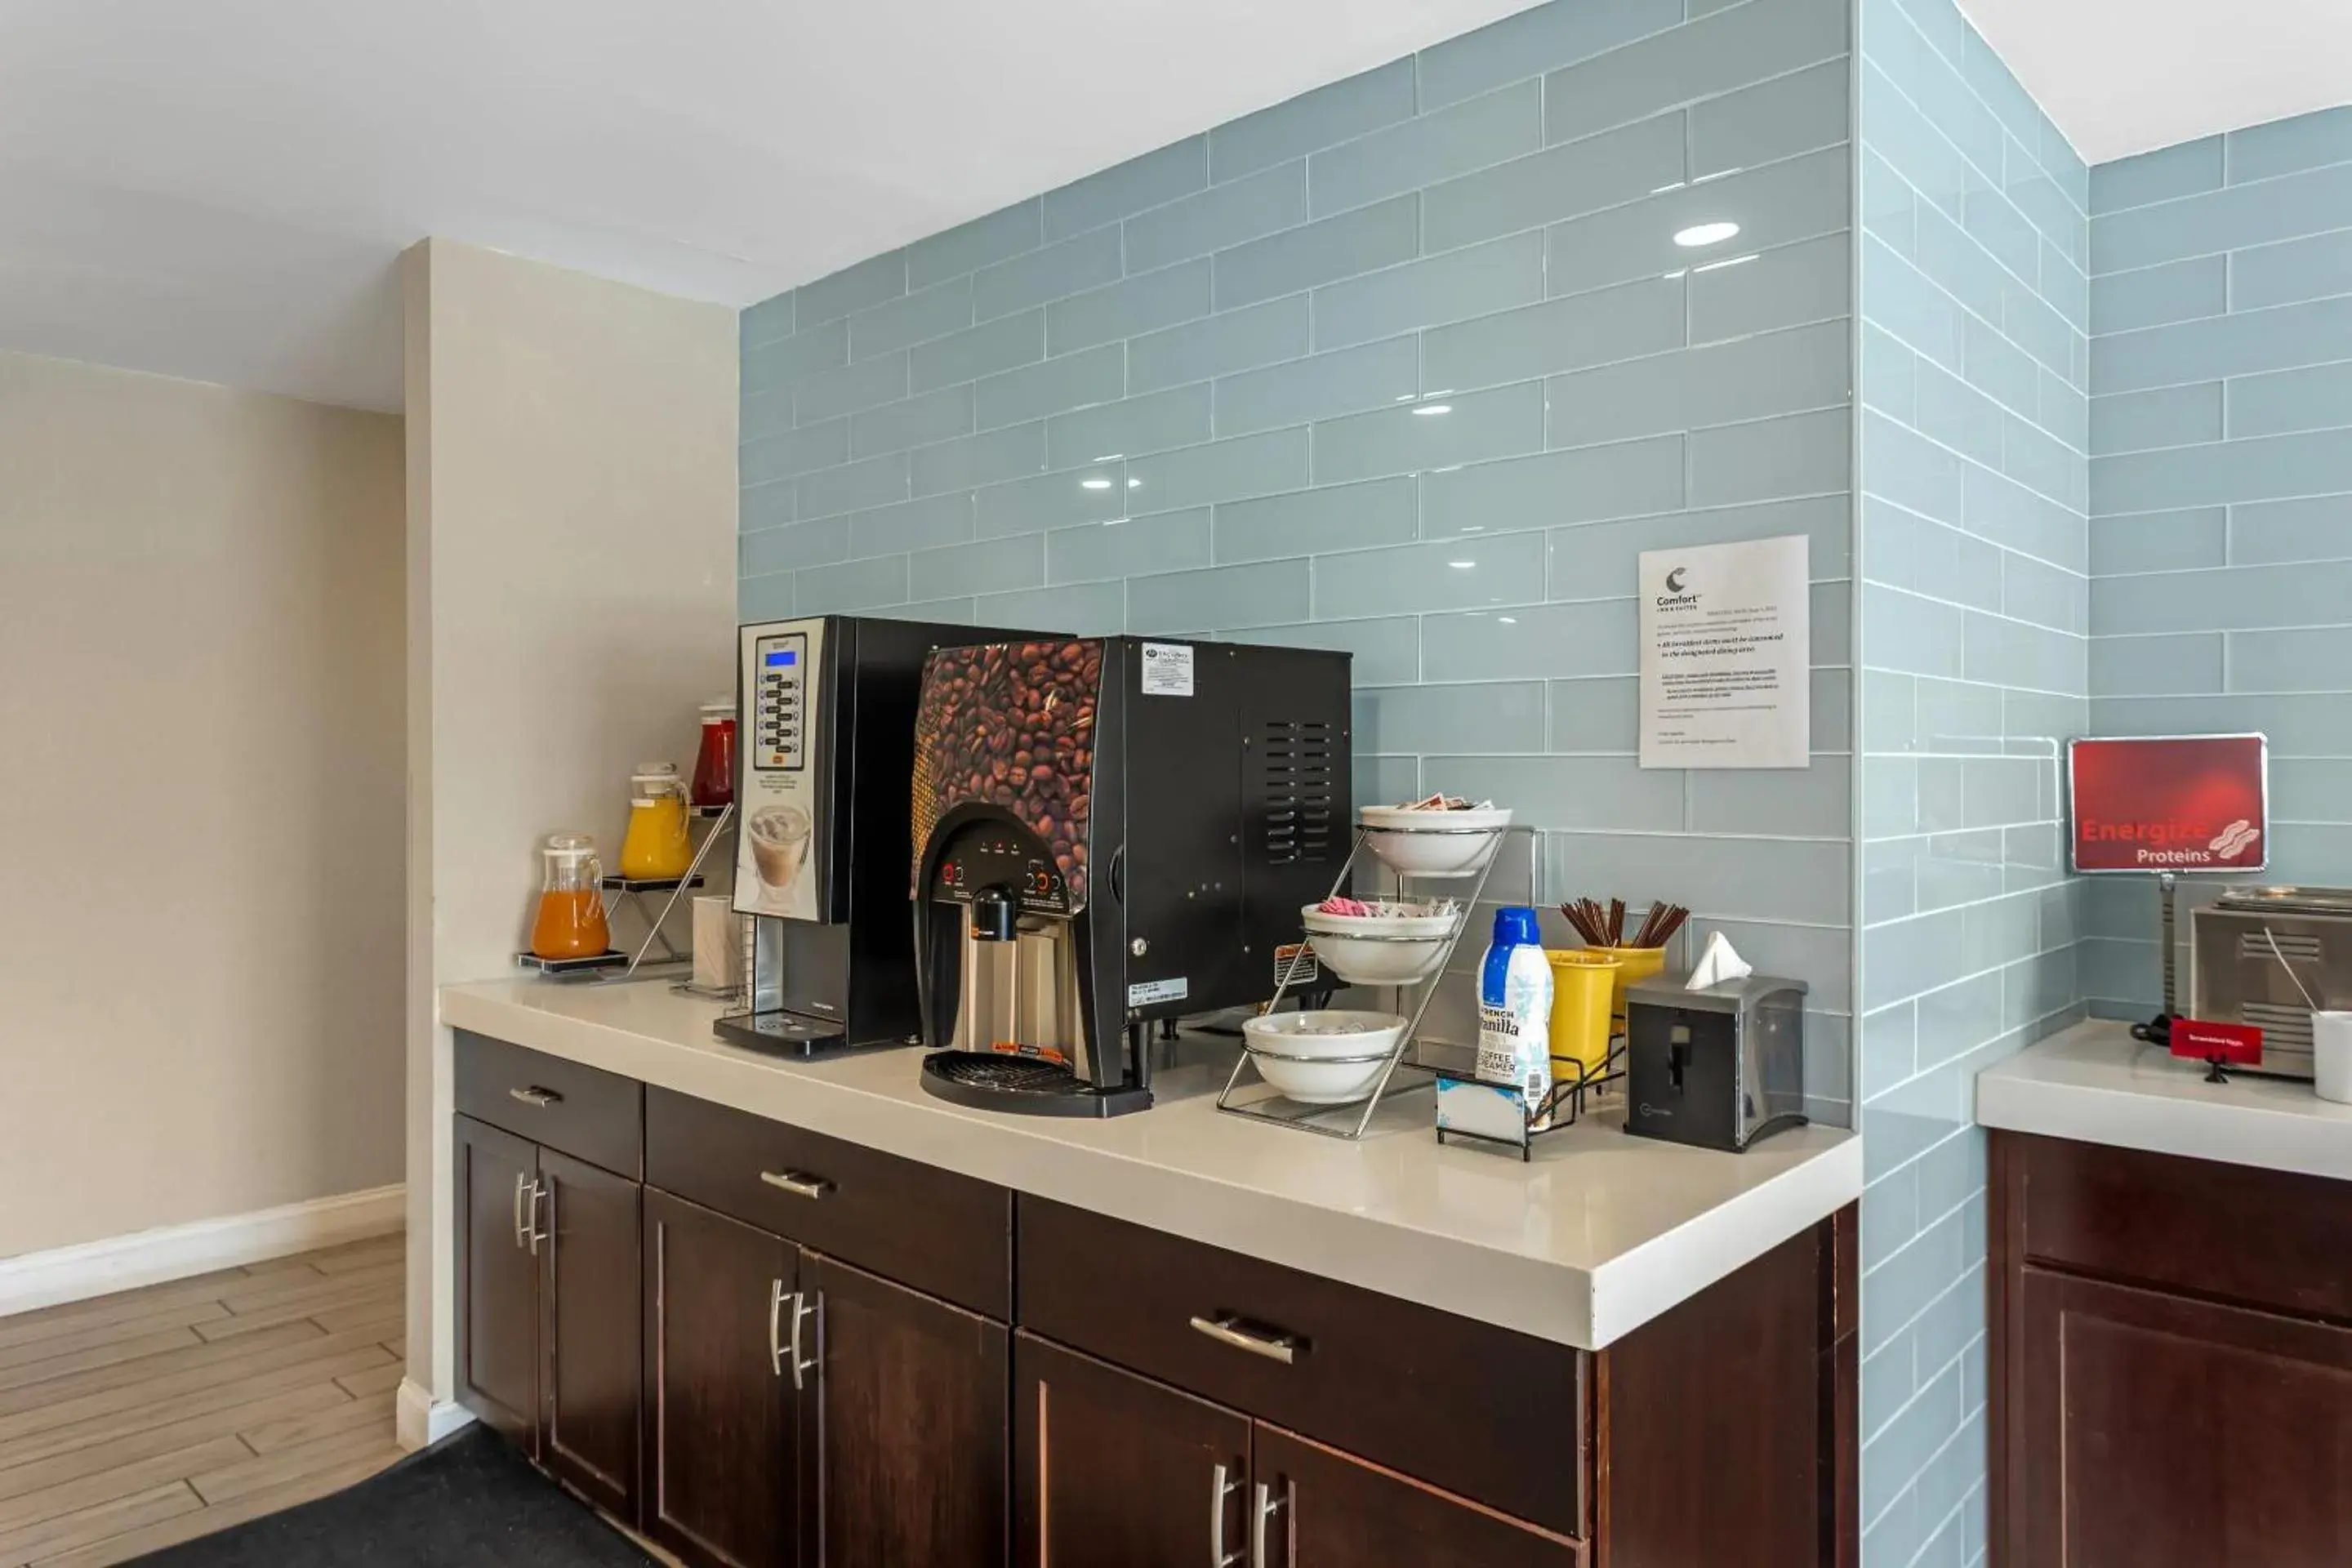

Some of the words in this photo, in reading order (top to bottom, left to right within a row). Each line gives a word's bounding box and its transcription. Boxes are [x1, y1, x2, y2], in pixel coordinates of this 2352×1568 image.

[1657, 595, 1697, 606] Comfort
[2082, 817, 2209, 845] Energize
[2136, 848, 2211, 863] Proteins
